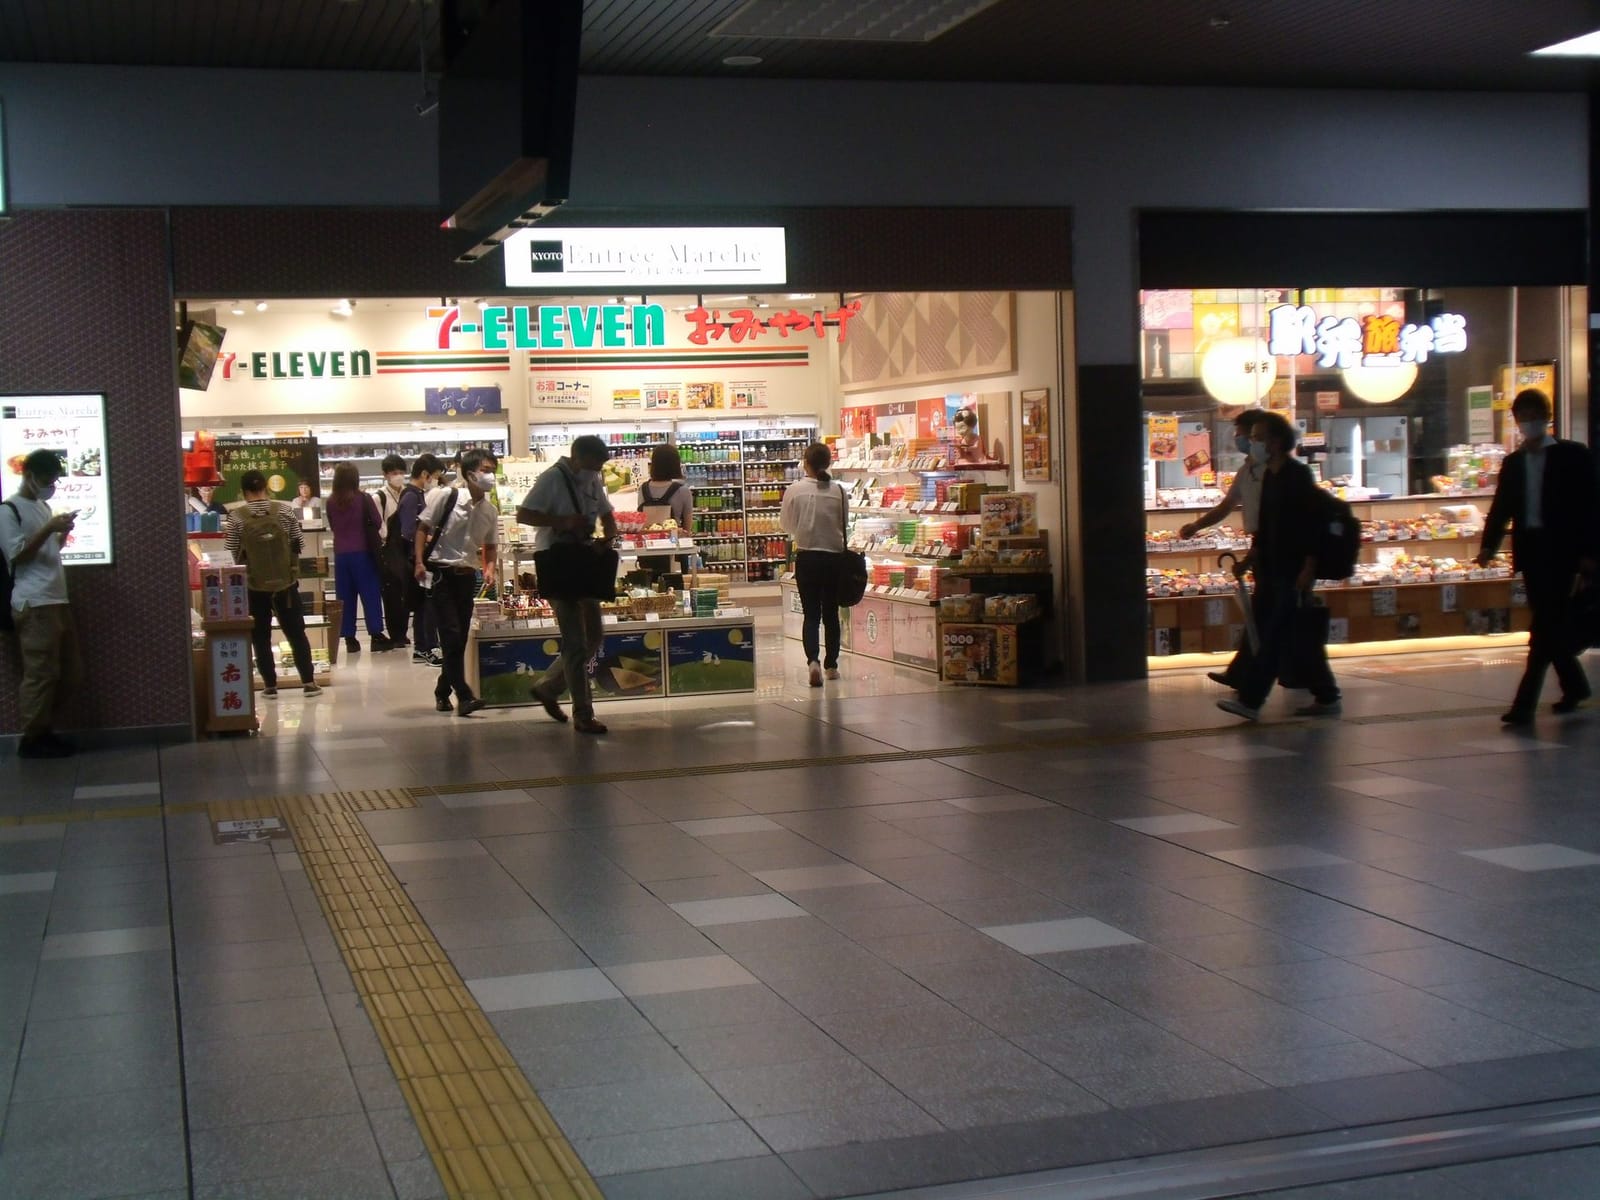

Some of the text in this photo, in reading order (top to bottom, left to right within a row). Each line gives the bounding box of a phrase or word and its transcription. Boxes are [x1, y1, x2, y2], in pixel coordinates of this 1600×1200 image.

[531, 251, 563, 261] KYOTO
[685, 300, 861, 345] おみやげ
[440, 395, 486, 411] おでん
[23, 426, 80, 440] おみやげ
[220, 663, 243, 711] 赤福
